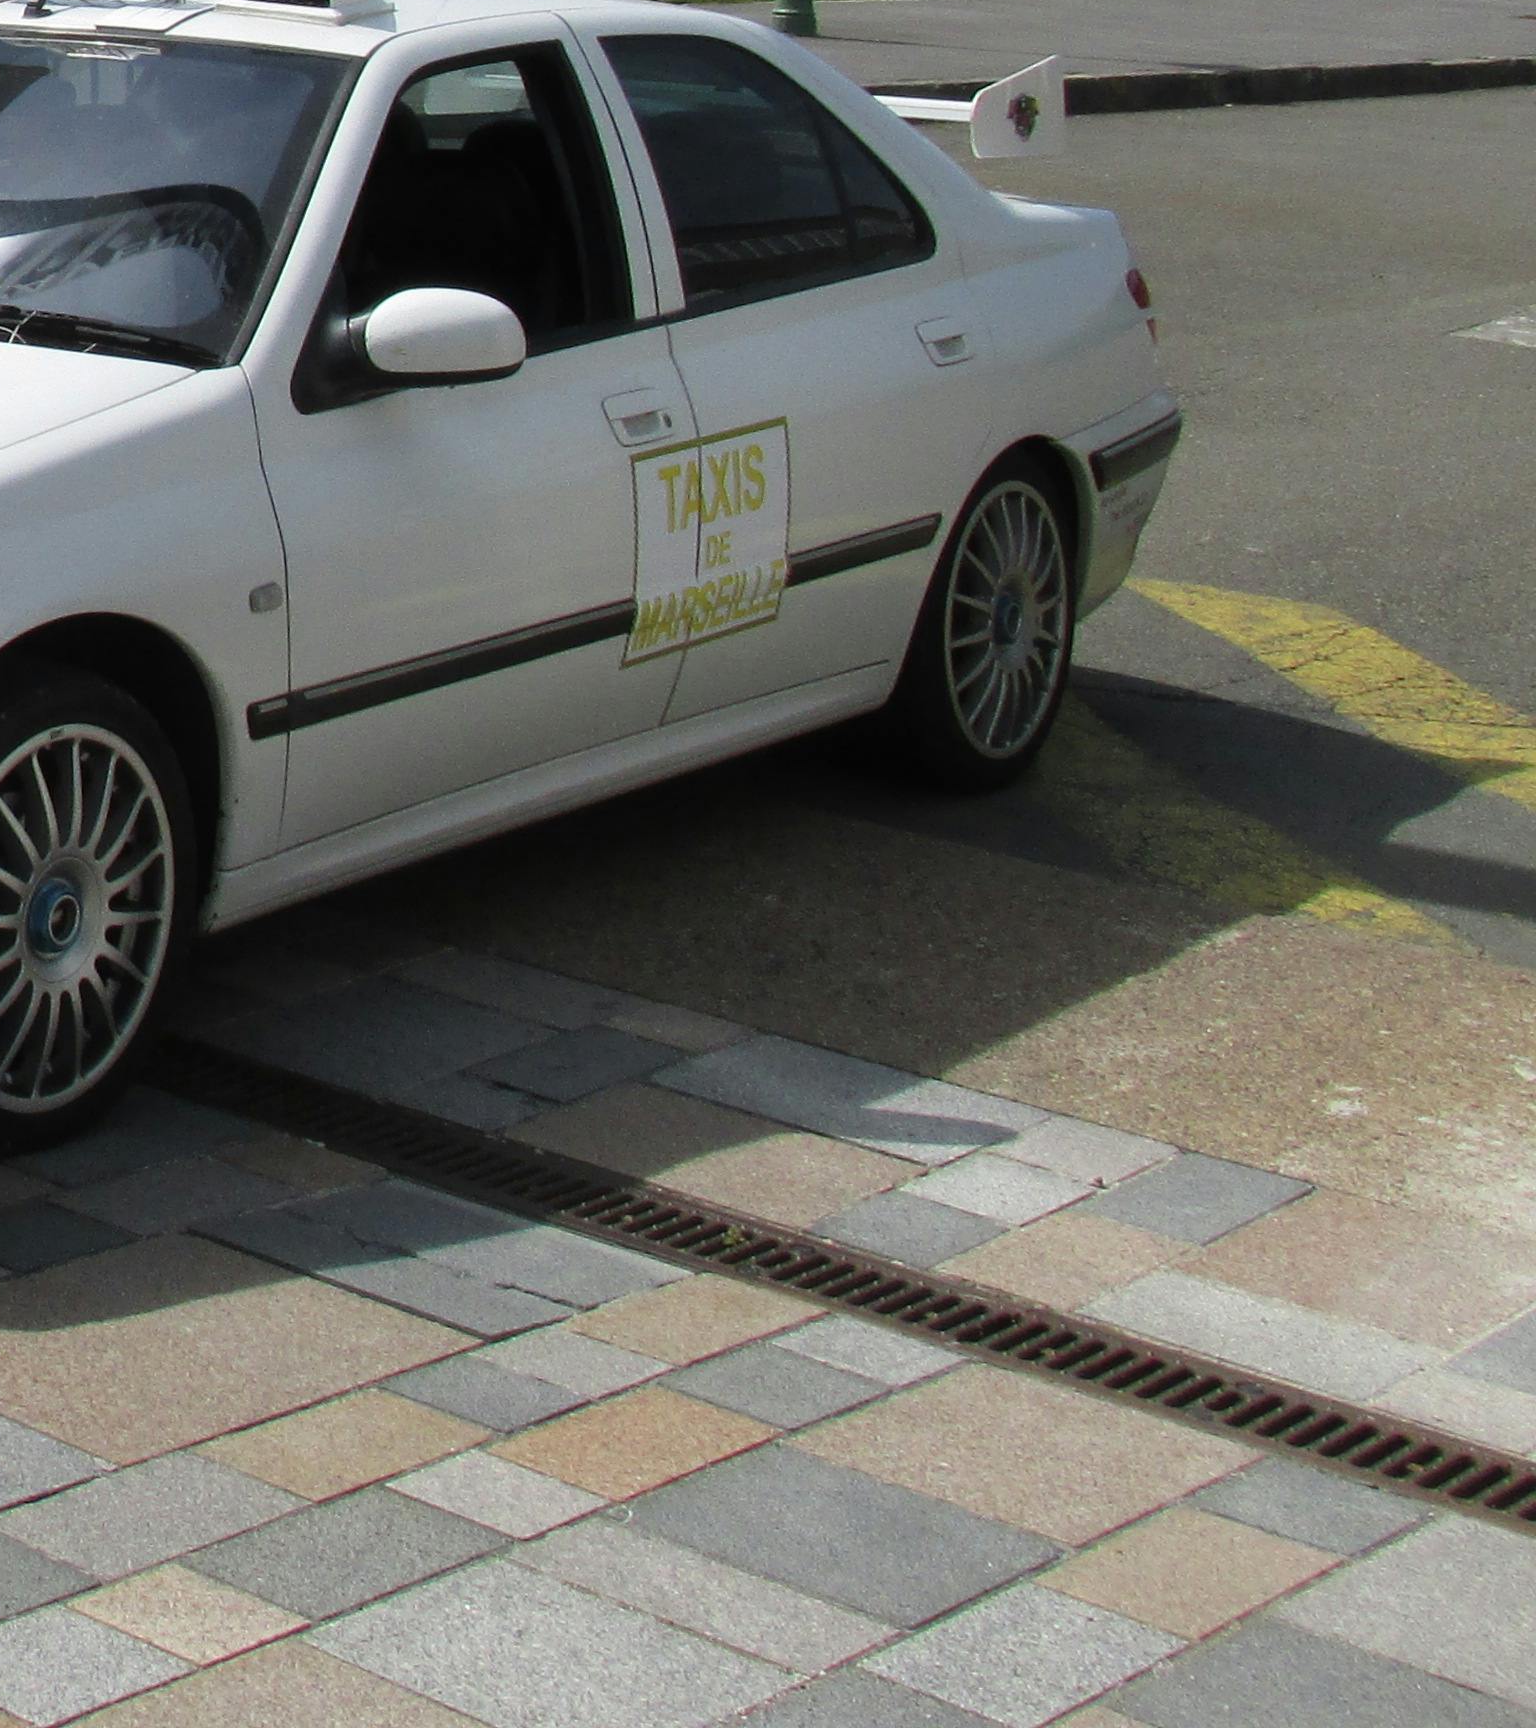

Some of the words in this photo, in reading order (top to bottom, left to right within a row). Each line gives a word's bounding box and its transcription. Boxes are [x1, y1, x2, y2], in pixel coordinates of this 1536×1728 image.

[657, 442, 766, 534] TAXIS
[704, 530, 732, 570] DE
[630, 558, 785, 652] MARSEILLE
